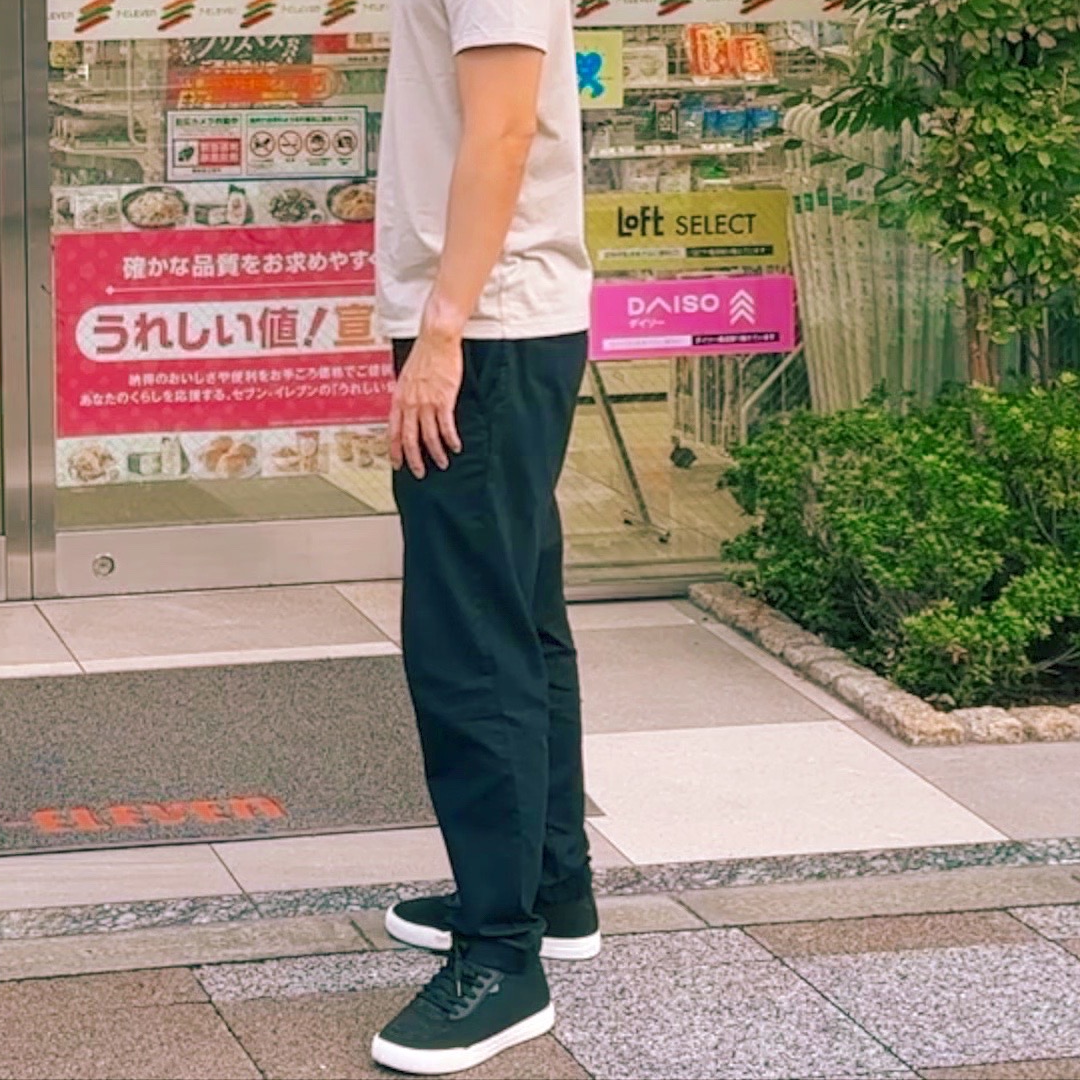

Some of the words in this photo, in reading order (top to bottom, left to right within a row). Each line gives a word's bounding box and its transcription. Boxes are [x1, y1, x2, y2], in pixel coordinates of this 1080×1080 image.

[617, 206, 664, 237] Loft
[675, 213, 757, 236] SELECT
[627, 293, 720, 316] DAISO
